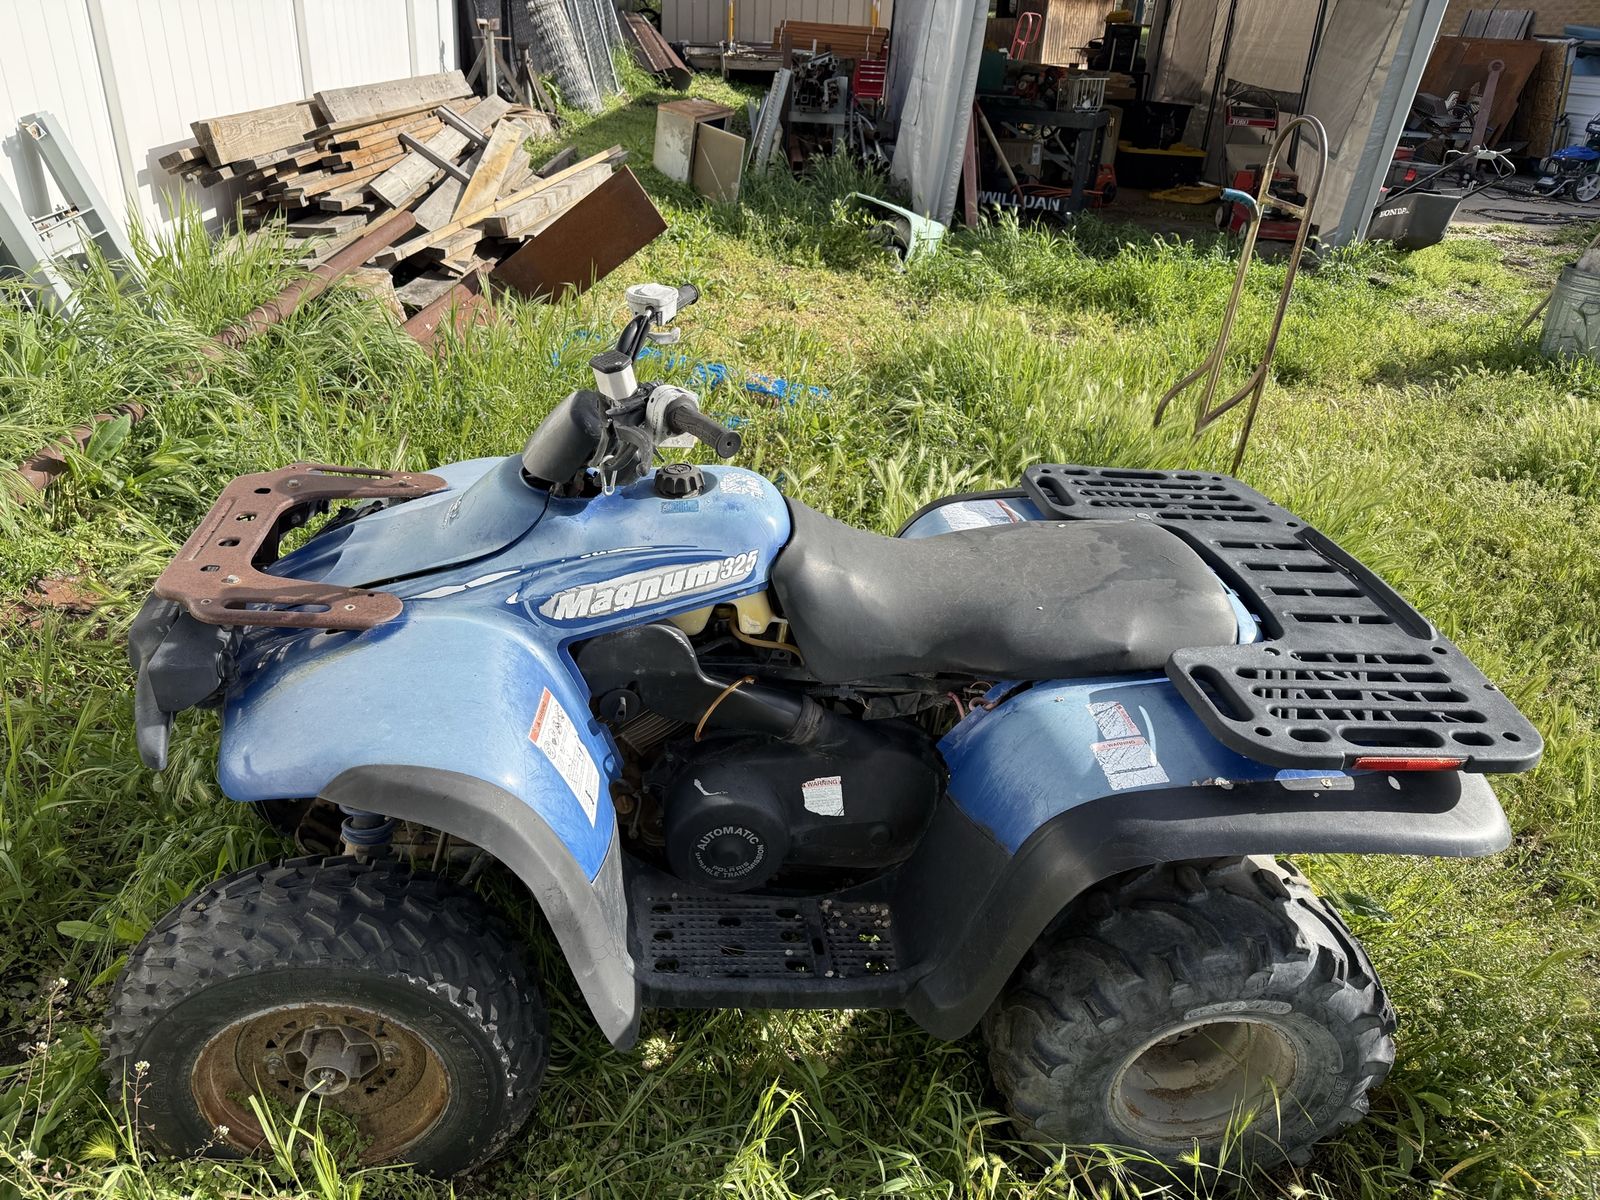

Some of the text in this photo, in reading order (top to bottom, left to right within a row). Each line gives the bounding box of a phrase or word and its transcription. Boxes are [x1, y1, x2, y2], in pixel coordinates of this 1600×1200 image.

[1379, 207, 1410, 218] HONDA
[553, 550, 759, 620] Magnum 325
[806, 779, 838, 788] WARNING
[697, 826, 759, 851] AUTOMATIC
[712, 861, 750, 873] POLARIS
[723, 844, 765, 878] TRANSMISSION
